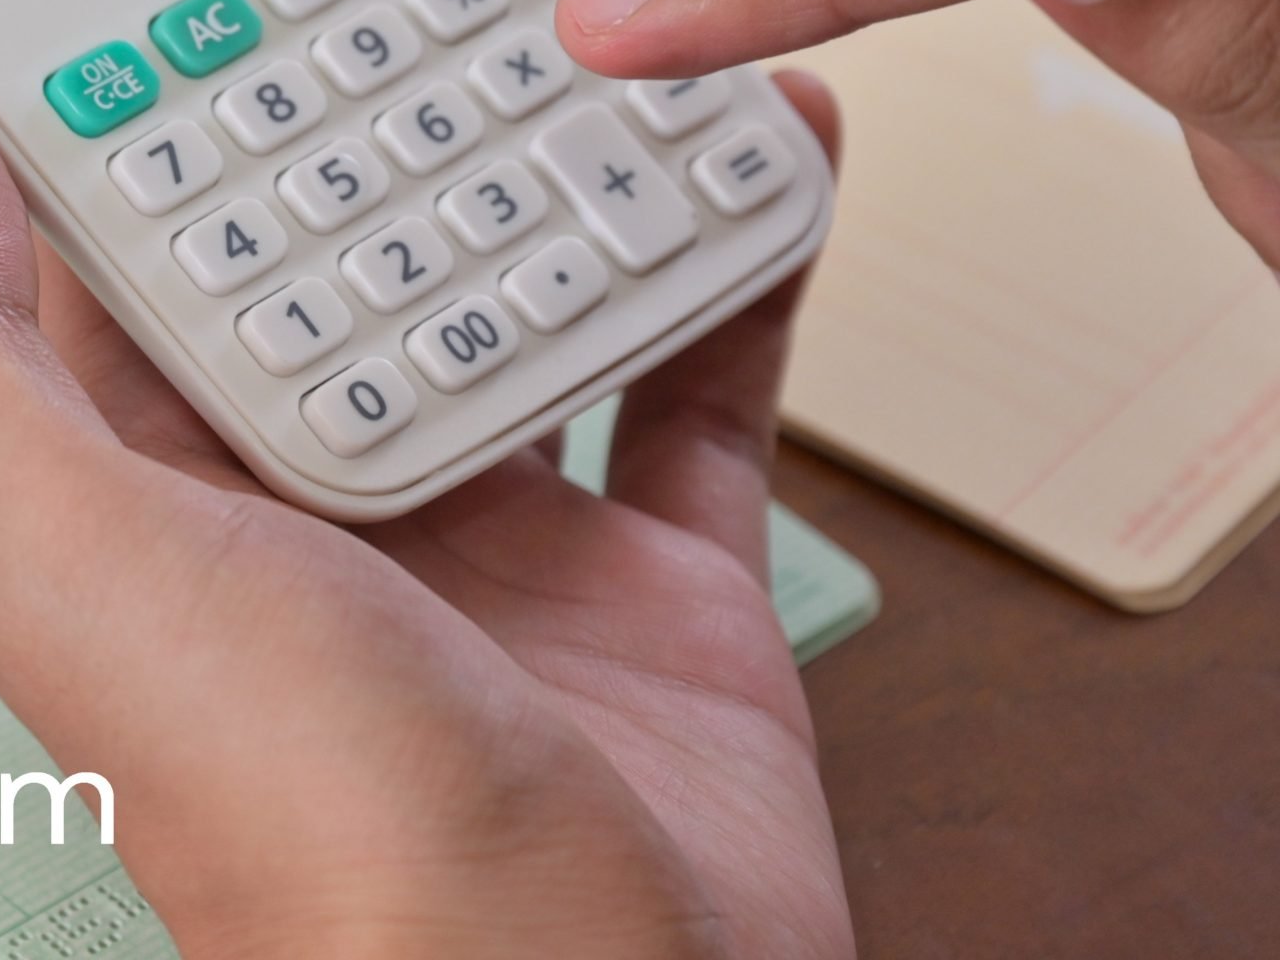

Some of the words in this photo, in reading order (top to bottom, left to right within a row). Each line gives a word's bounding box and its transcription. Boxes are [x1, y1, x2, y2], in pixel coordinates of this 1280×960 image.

[186, 1, 242, 52] AC
[351, 27, 390, 68] 9
[80, 52, 120, 85] ON
[255, 82, 298, 124] 8
[416, 102, 455, 144] 6
[147, 139, 183, 185] 7
[317, 157, 360, 203] 5
[603, 164, 636, 199] +
[476, 182, 518, 225] 3
[224, 219, 259, 259] 4
[382, 240, 427, 284] 2
[285, 300, 322, 339] 1
[440, 309, 501, 366] 00
[347, 380, 388, 422] 0
